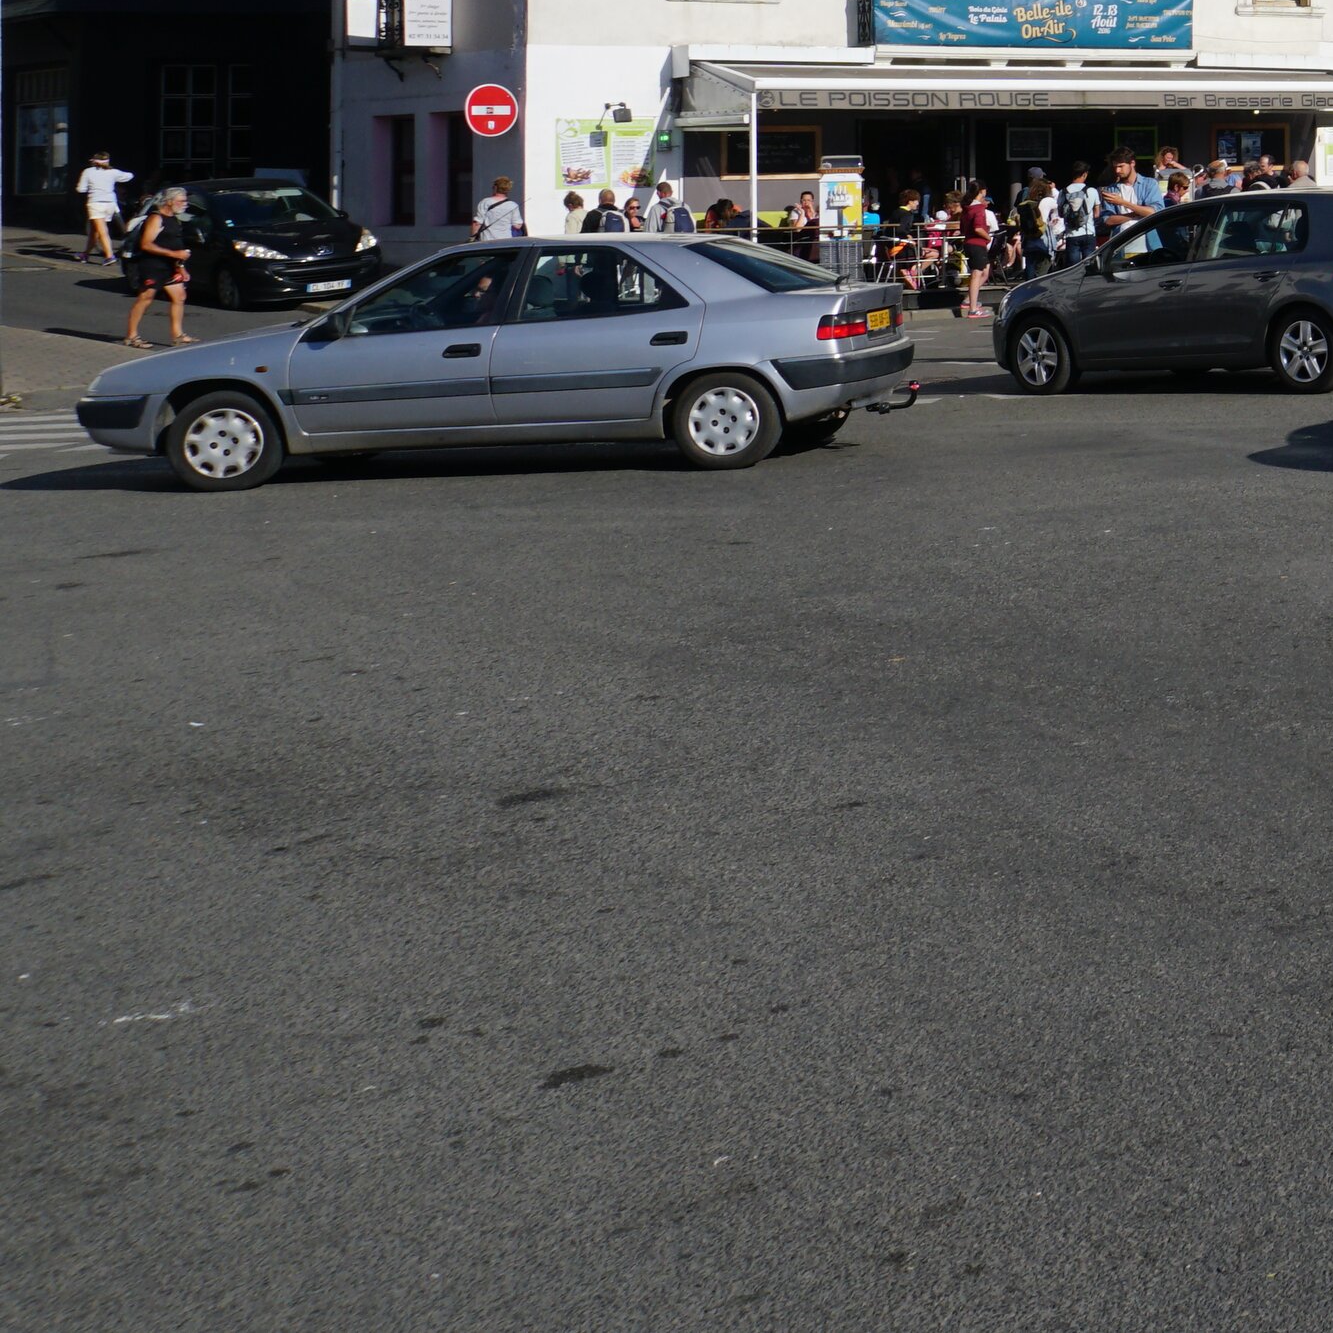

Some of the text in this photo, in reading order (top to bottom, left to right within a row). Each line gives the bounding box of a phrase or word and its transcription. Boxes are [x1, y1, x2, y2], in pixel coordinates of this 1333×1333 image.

[979, 14, 1008, 23] Palais
[1091, 16, 1118, 29] Août
[778, 92, 1049, 107] LE POISSON ROUGE
[1163, 93, 1197, 107] Bar
[1204, 93, 1293, 108] Brasserie
